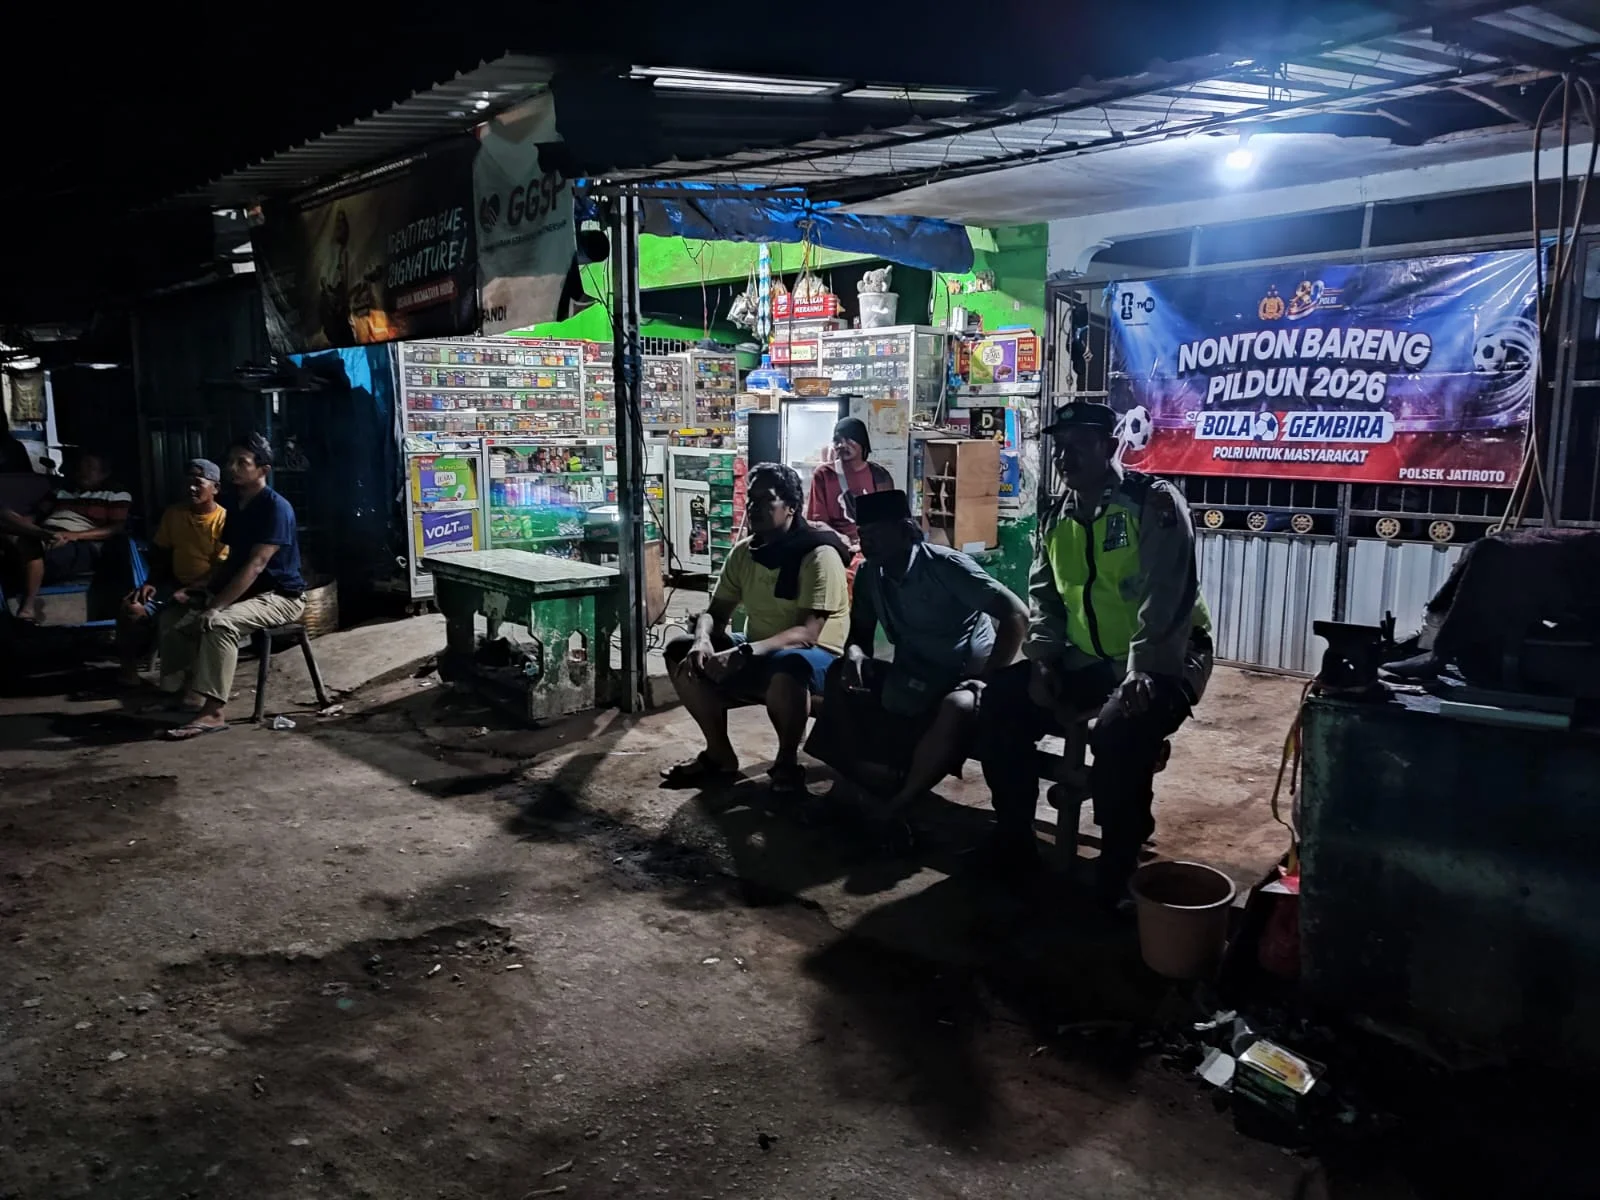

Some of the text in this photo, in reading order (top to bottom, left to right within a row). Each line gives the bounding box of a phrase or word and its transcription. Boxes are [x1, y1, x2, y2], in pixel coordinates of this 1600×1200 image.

[1178, 327, 1431, 372] NONTON BARENG
[1206, 367, 1387, 404] PILDUN 2026
[1202, 414, 1383, 439] BOLA GEMBIRA
[1212, 446, 1368, 463] POLRI UNTUK MASYARAKAT
[1399, 467, 1505, 482] POLSEK JATIROTO
[425, 520, 460, 539] VOLT
